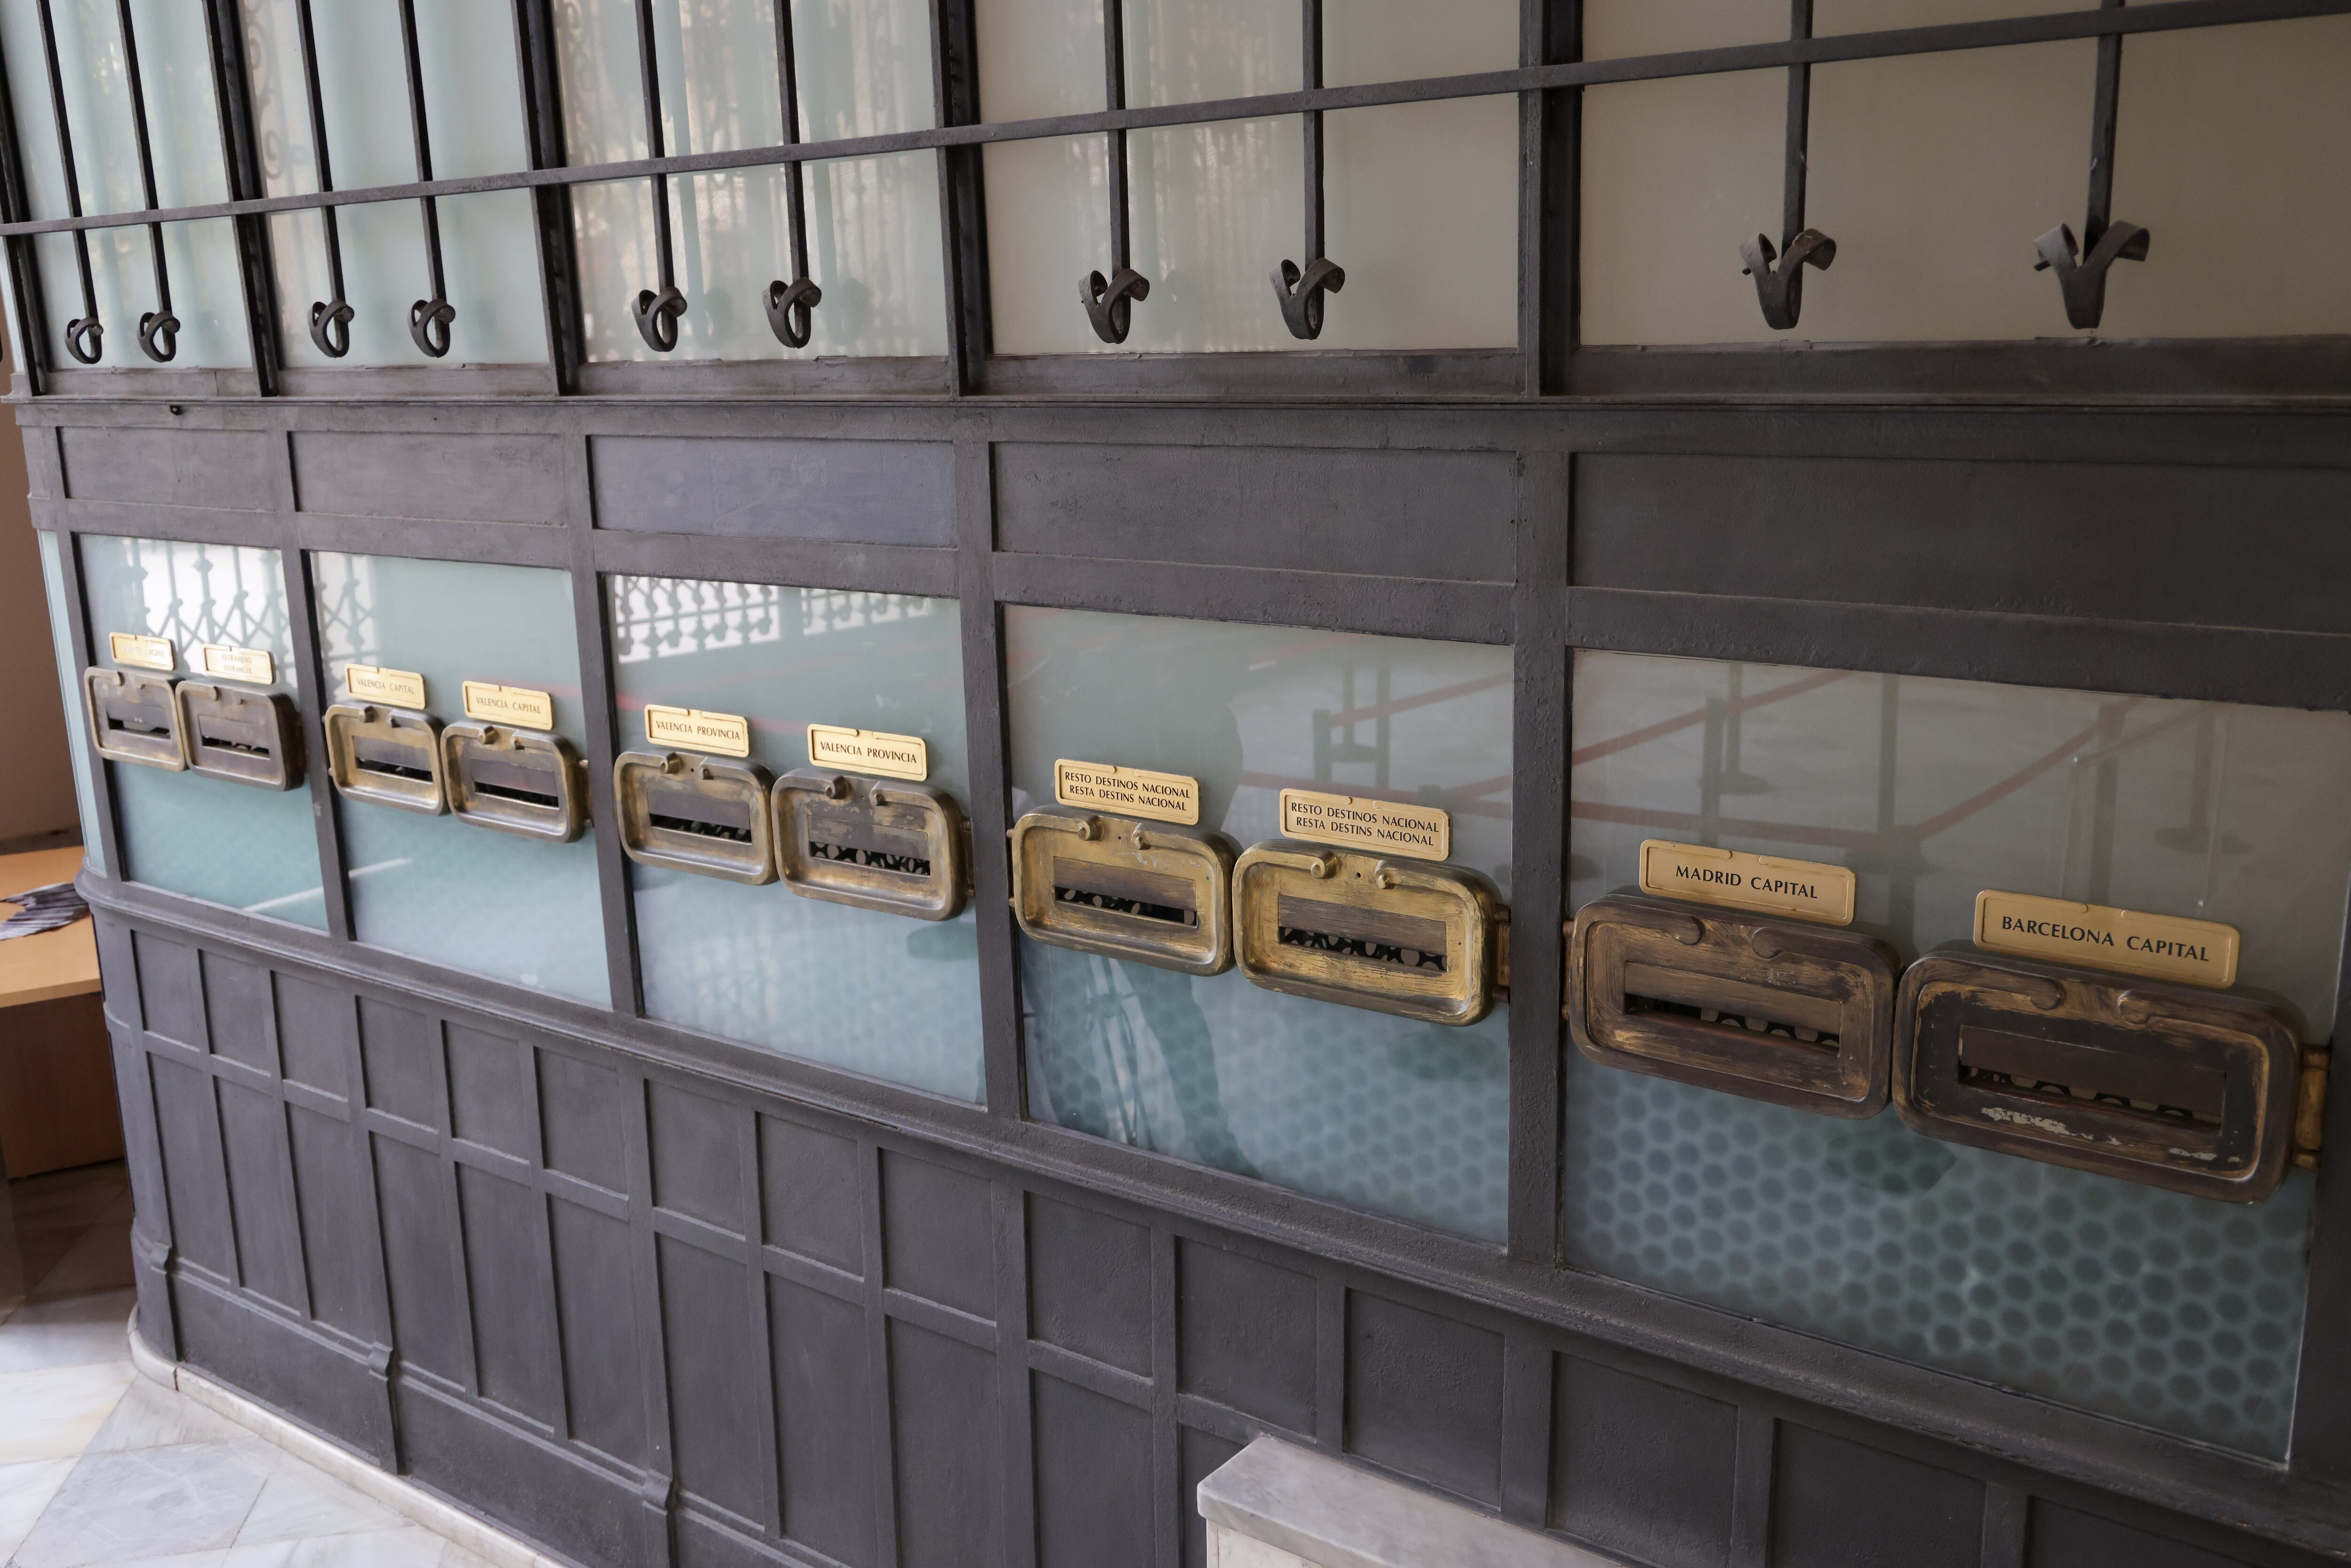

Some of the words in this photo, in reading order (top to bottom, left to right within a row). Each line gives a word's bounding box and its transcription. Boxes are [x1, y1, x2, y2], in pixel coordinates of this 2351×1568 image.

[224, 664, 252, 674] ESTRANGER
[357, 678, 386, 690] VALENCIA
[389, 683, 415, 695] CAPITAL
[476, 696, 508, 709] VALENCIA
[513, 701, 541, 714] CAPITAL
[656, 721, 693, 733] VALENCIA
[697, 726, 740, 740] PROVINCIA
[820, 741, 862, 756] VALENCIA
[867, 747, 917, 764] PROVINCIA
[1065, 771, 1091, 784] RESTO
[1096, 776, 1138, 790] DESTINOS
[1142, 782, 1191, 798] NACIONAL
[1070, 785, 1095, 797] RESTA
[1099, 789, 1134, 803] DESTINS
[1138, 795, 1186, 811] NACIONAL
[1291, 803, 1323, 816] RESTO
[1327, 807, 1377, 823] DESTINOS
[1382, 814, 1439, 833] NACIONAL
[1296, 817, 1325, 829] RESTA
[1330, 820, 1372, 836] DESTINS
[1377, 828, 1434, 846] NACIONAL
[1675, 865, 1742, 886] MADRID
[1750, 876, 1818, 899] CAPITAL
[2001, 915, 2114, 947] BARCELONA
[2126, 935, 2209, 961] CAPITAL
